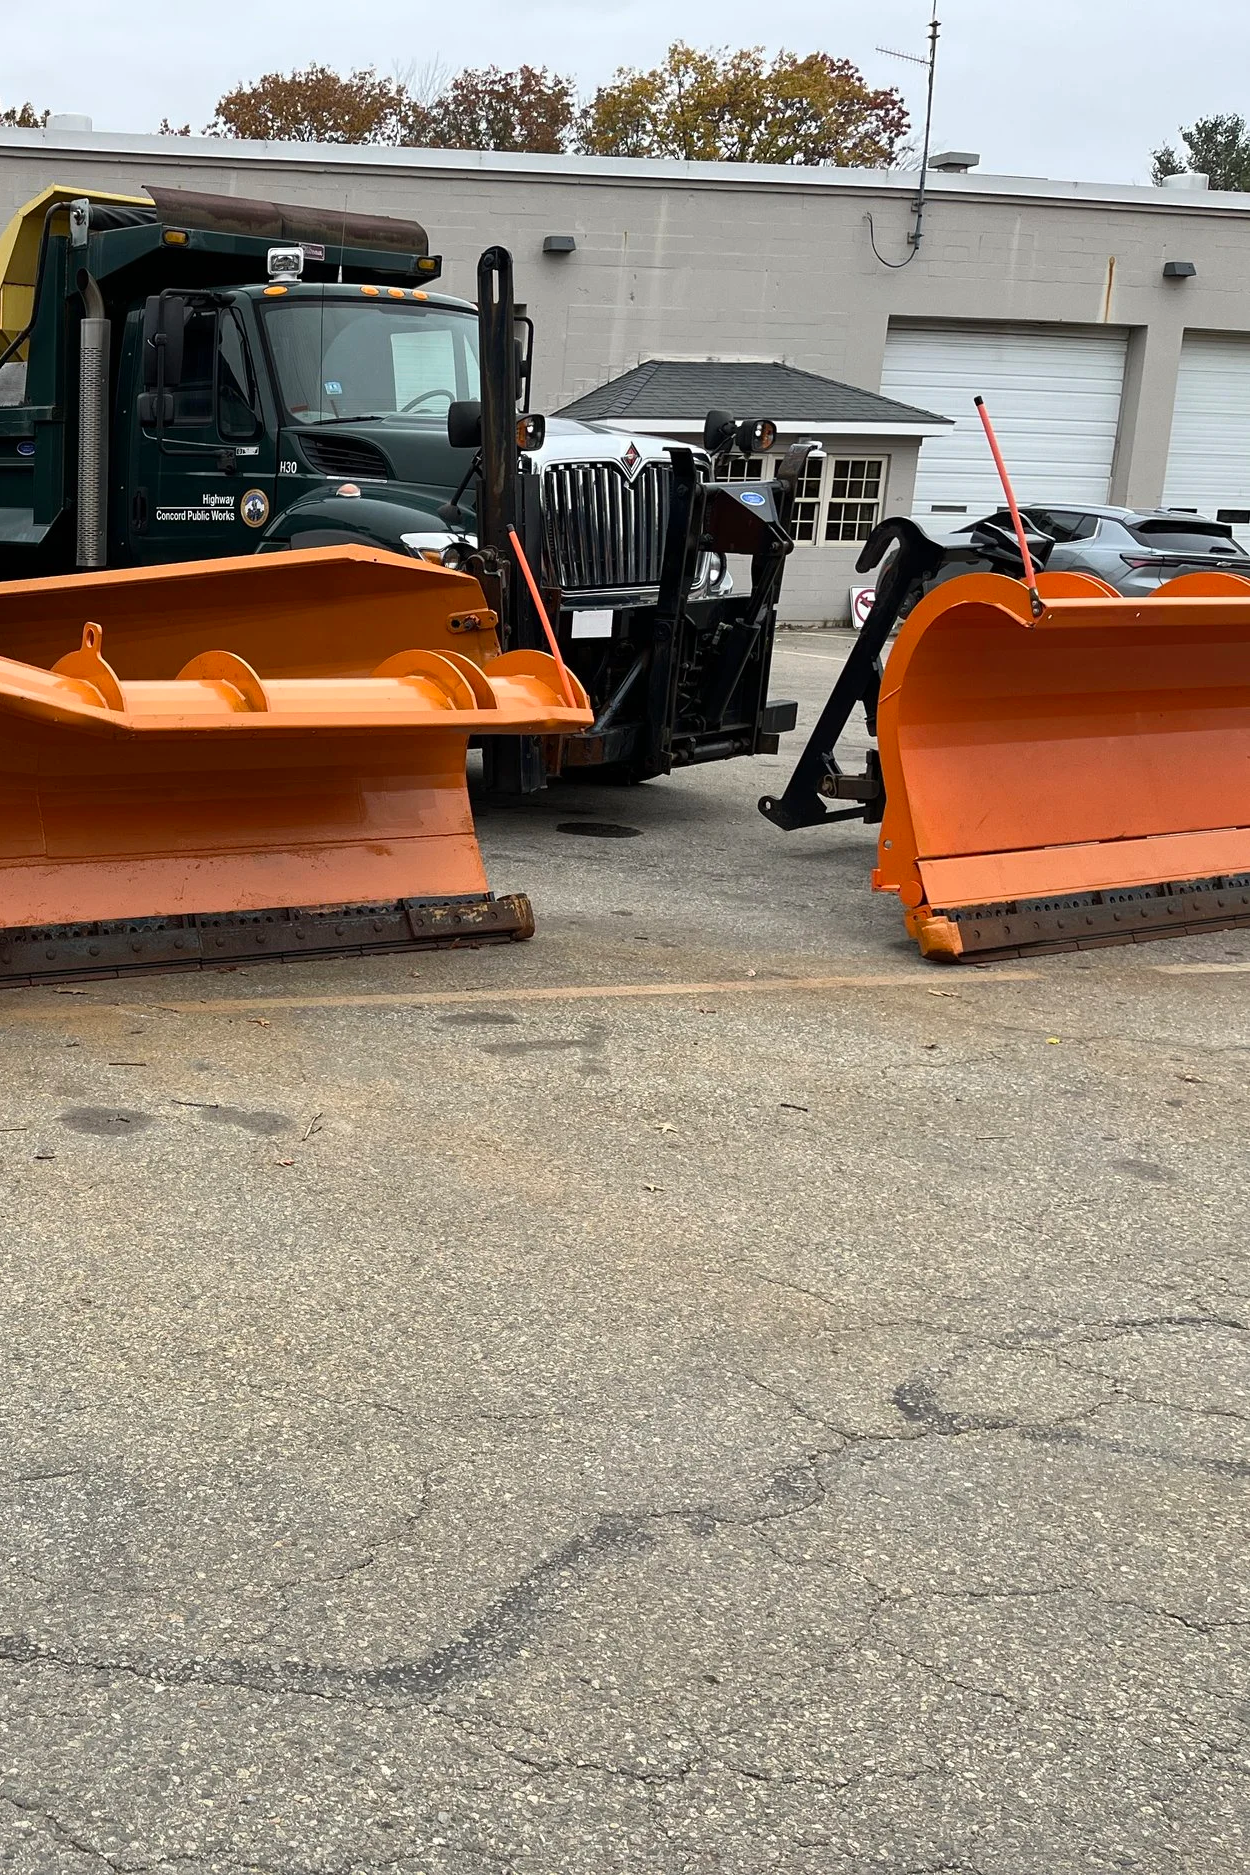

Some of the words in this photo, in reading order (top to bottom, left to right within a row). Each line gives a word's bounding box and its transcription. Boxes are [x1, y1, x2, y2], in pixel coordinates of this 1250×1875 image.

[280, 461, 297, 473] H30
[202, 494, 235, 506] Highway
[156, 511, 186, 521] Concord
[187, 510, 210, 521] Public
[211, 511, 235, 521] Works
